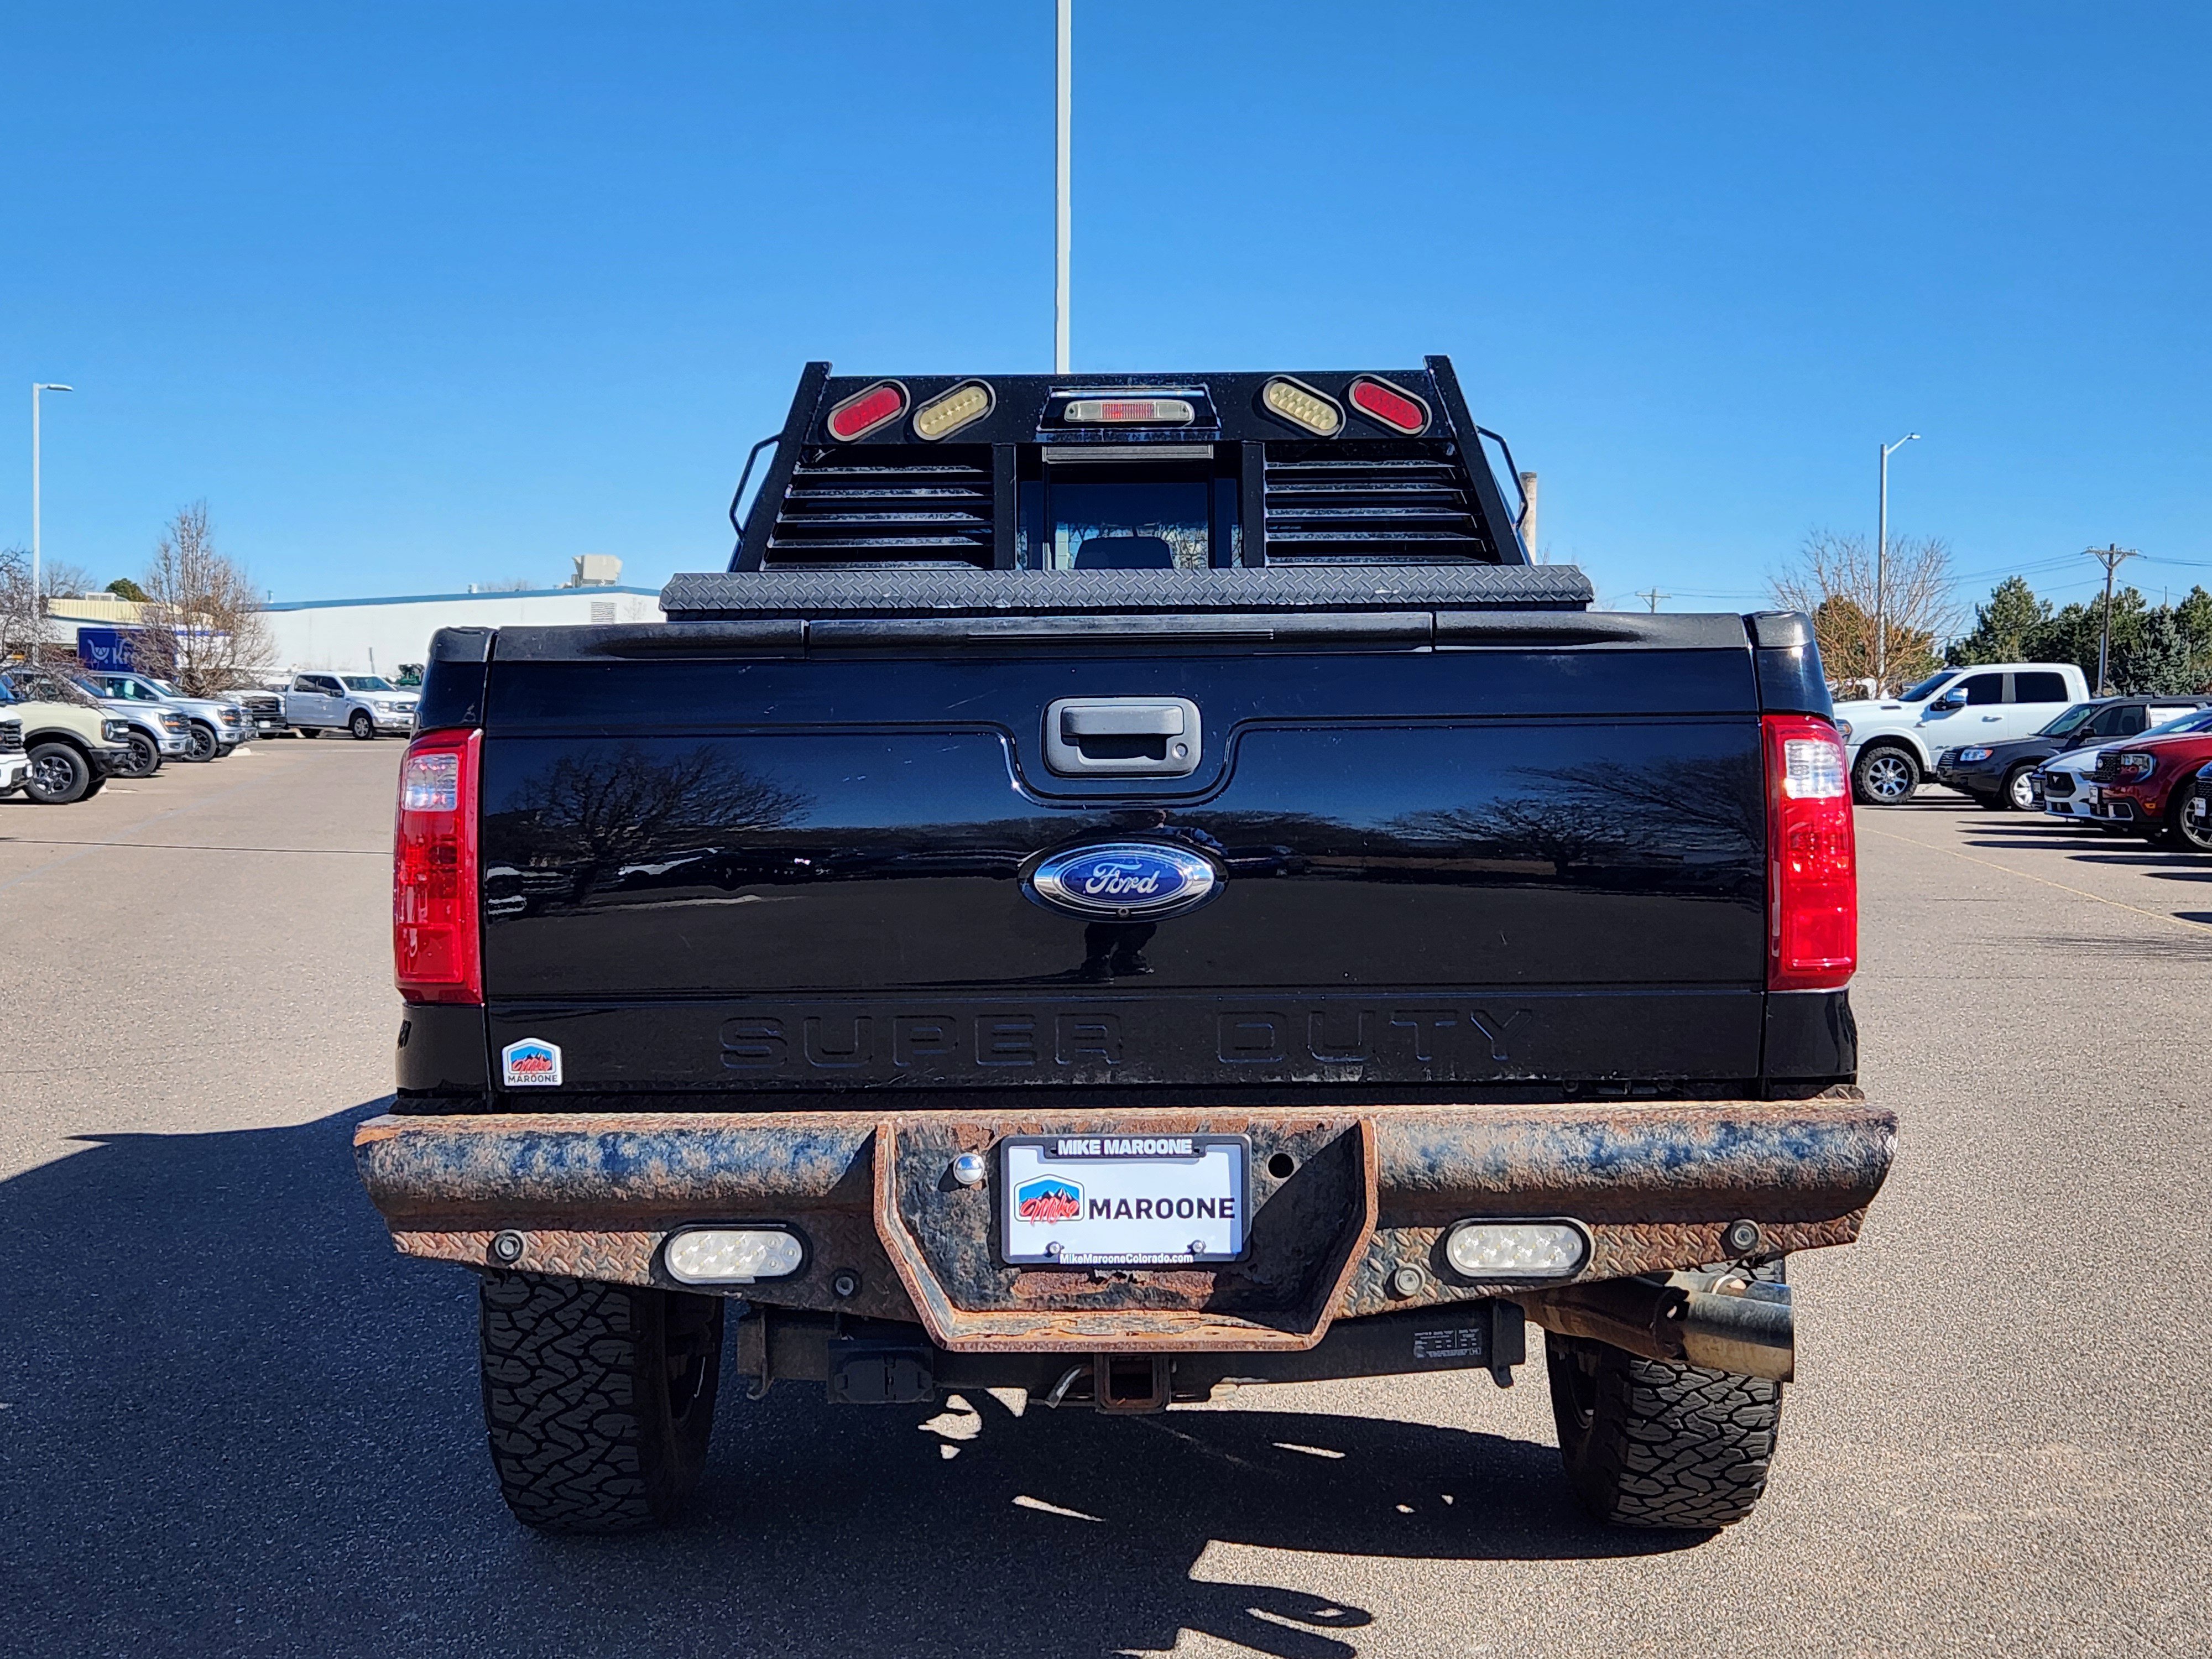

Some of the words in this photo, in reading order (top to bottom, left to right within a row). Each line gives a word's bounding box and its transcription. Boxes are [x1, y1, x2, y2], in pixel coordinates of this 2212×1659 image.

[1085, 862, 1160, 894] Ford
[720, 1014, 1121, 1068] SUPER
[1217, 1009, 1532, 1062] DUTY
[508, 1074, 558, 1083] MAROONE
[1057, 1139, 1101, 1156] MIKE
[1104, 1139, 1193, 1155] MAROONE
[1020, 1196, 1080, 1226] Mike
[1088, 1197, 1235, 1220] MAROONE
[1059, 1253, 1193, 1265] MikeMarooneColorado.com
